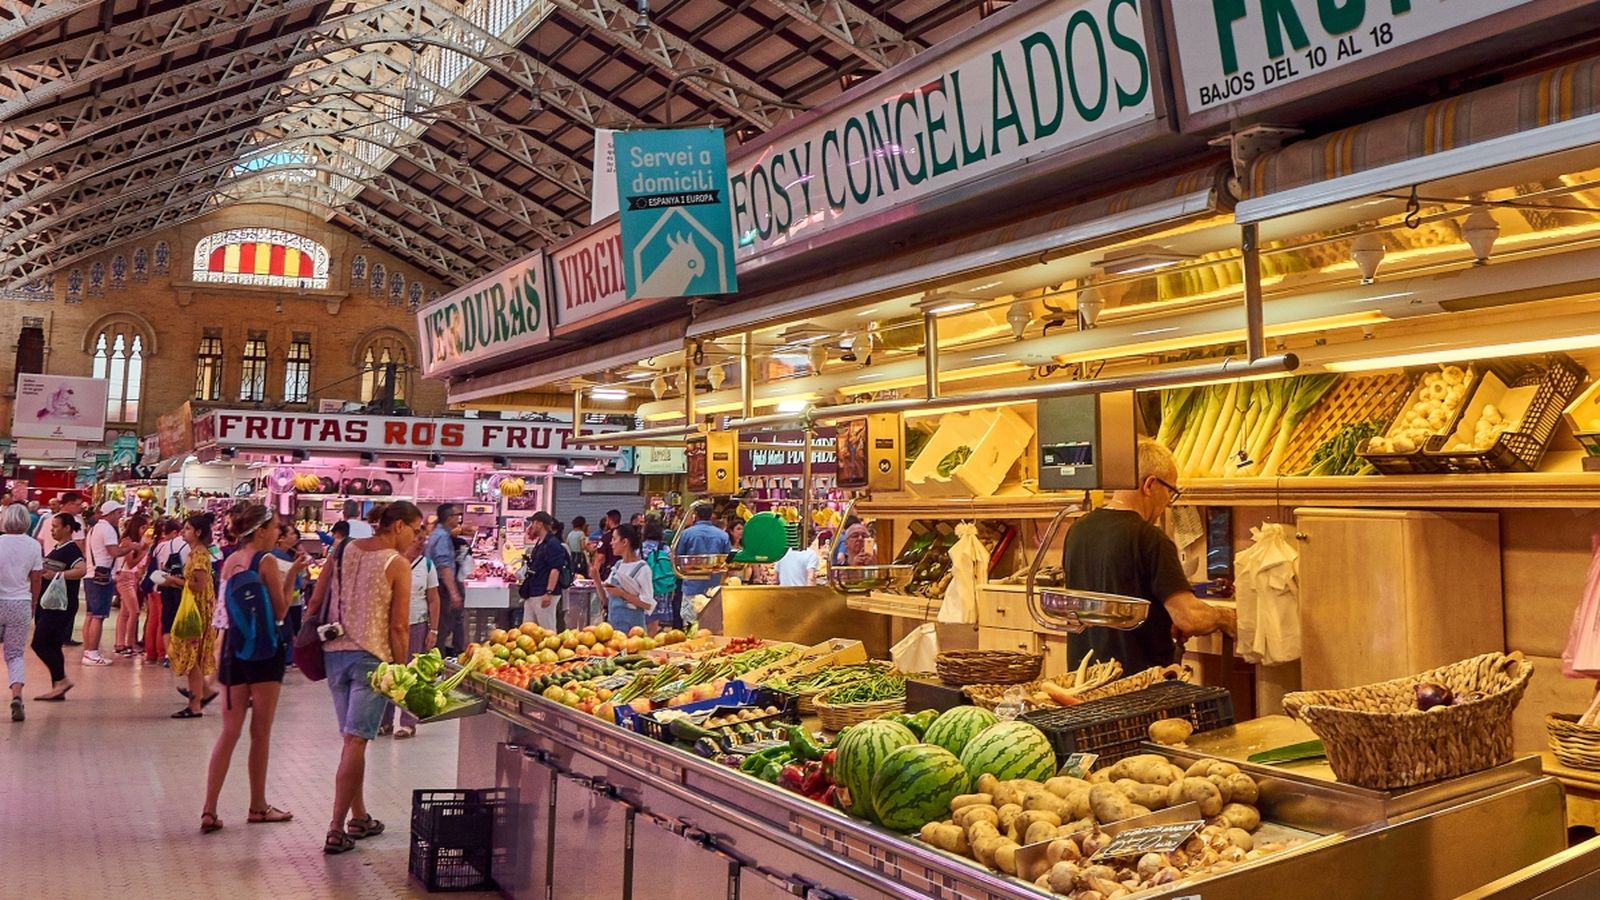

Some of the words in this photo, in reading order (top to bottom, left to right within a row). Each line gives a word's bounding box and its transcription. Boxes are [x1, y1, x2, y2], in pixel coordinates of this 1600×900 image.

[1199, 71, 1255, 105] BAJOS
[1263, 58, 1299, 85] DEL
[1305, 46, 1327, 69] 10
[1337, 36, 1362, 60] AL
[1369, 23, 1394, 47] 18
[789, 141, 811, 217] Y
[822, 0, 1148, 212] CONGELADOS
[630, 145, 694, 168] Servei
[700, 150, 711, 165] a
[632, 169, 714, 193] domicili
[648, 196, 680, 207] ESPANYA
[686, 194, 714, 203] EUROPA
[424, 266, 541, 364] VERDURAS
[219, 415, 369, 443] FRUTAS
[384, 421, 465, 447] ROS
